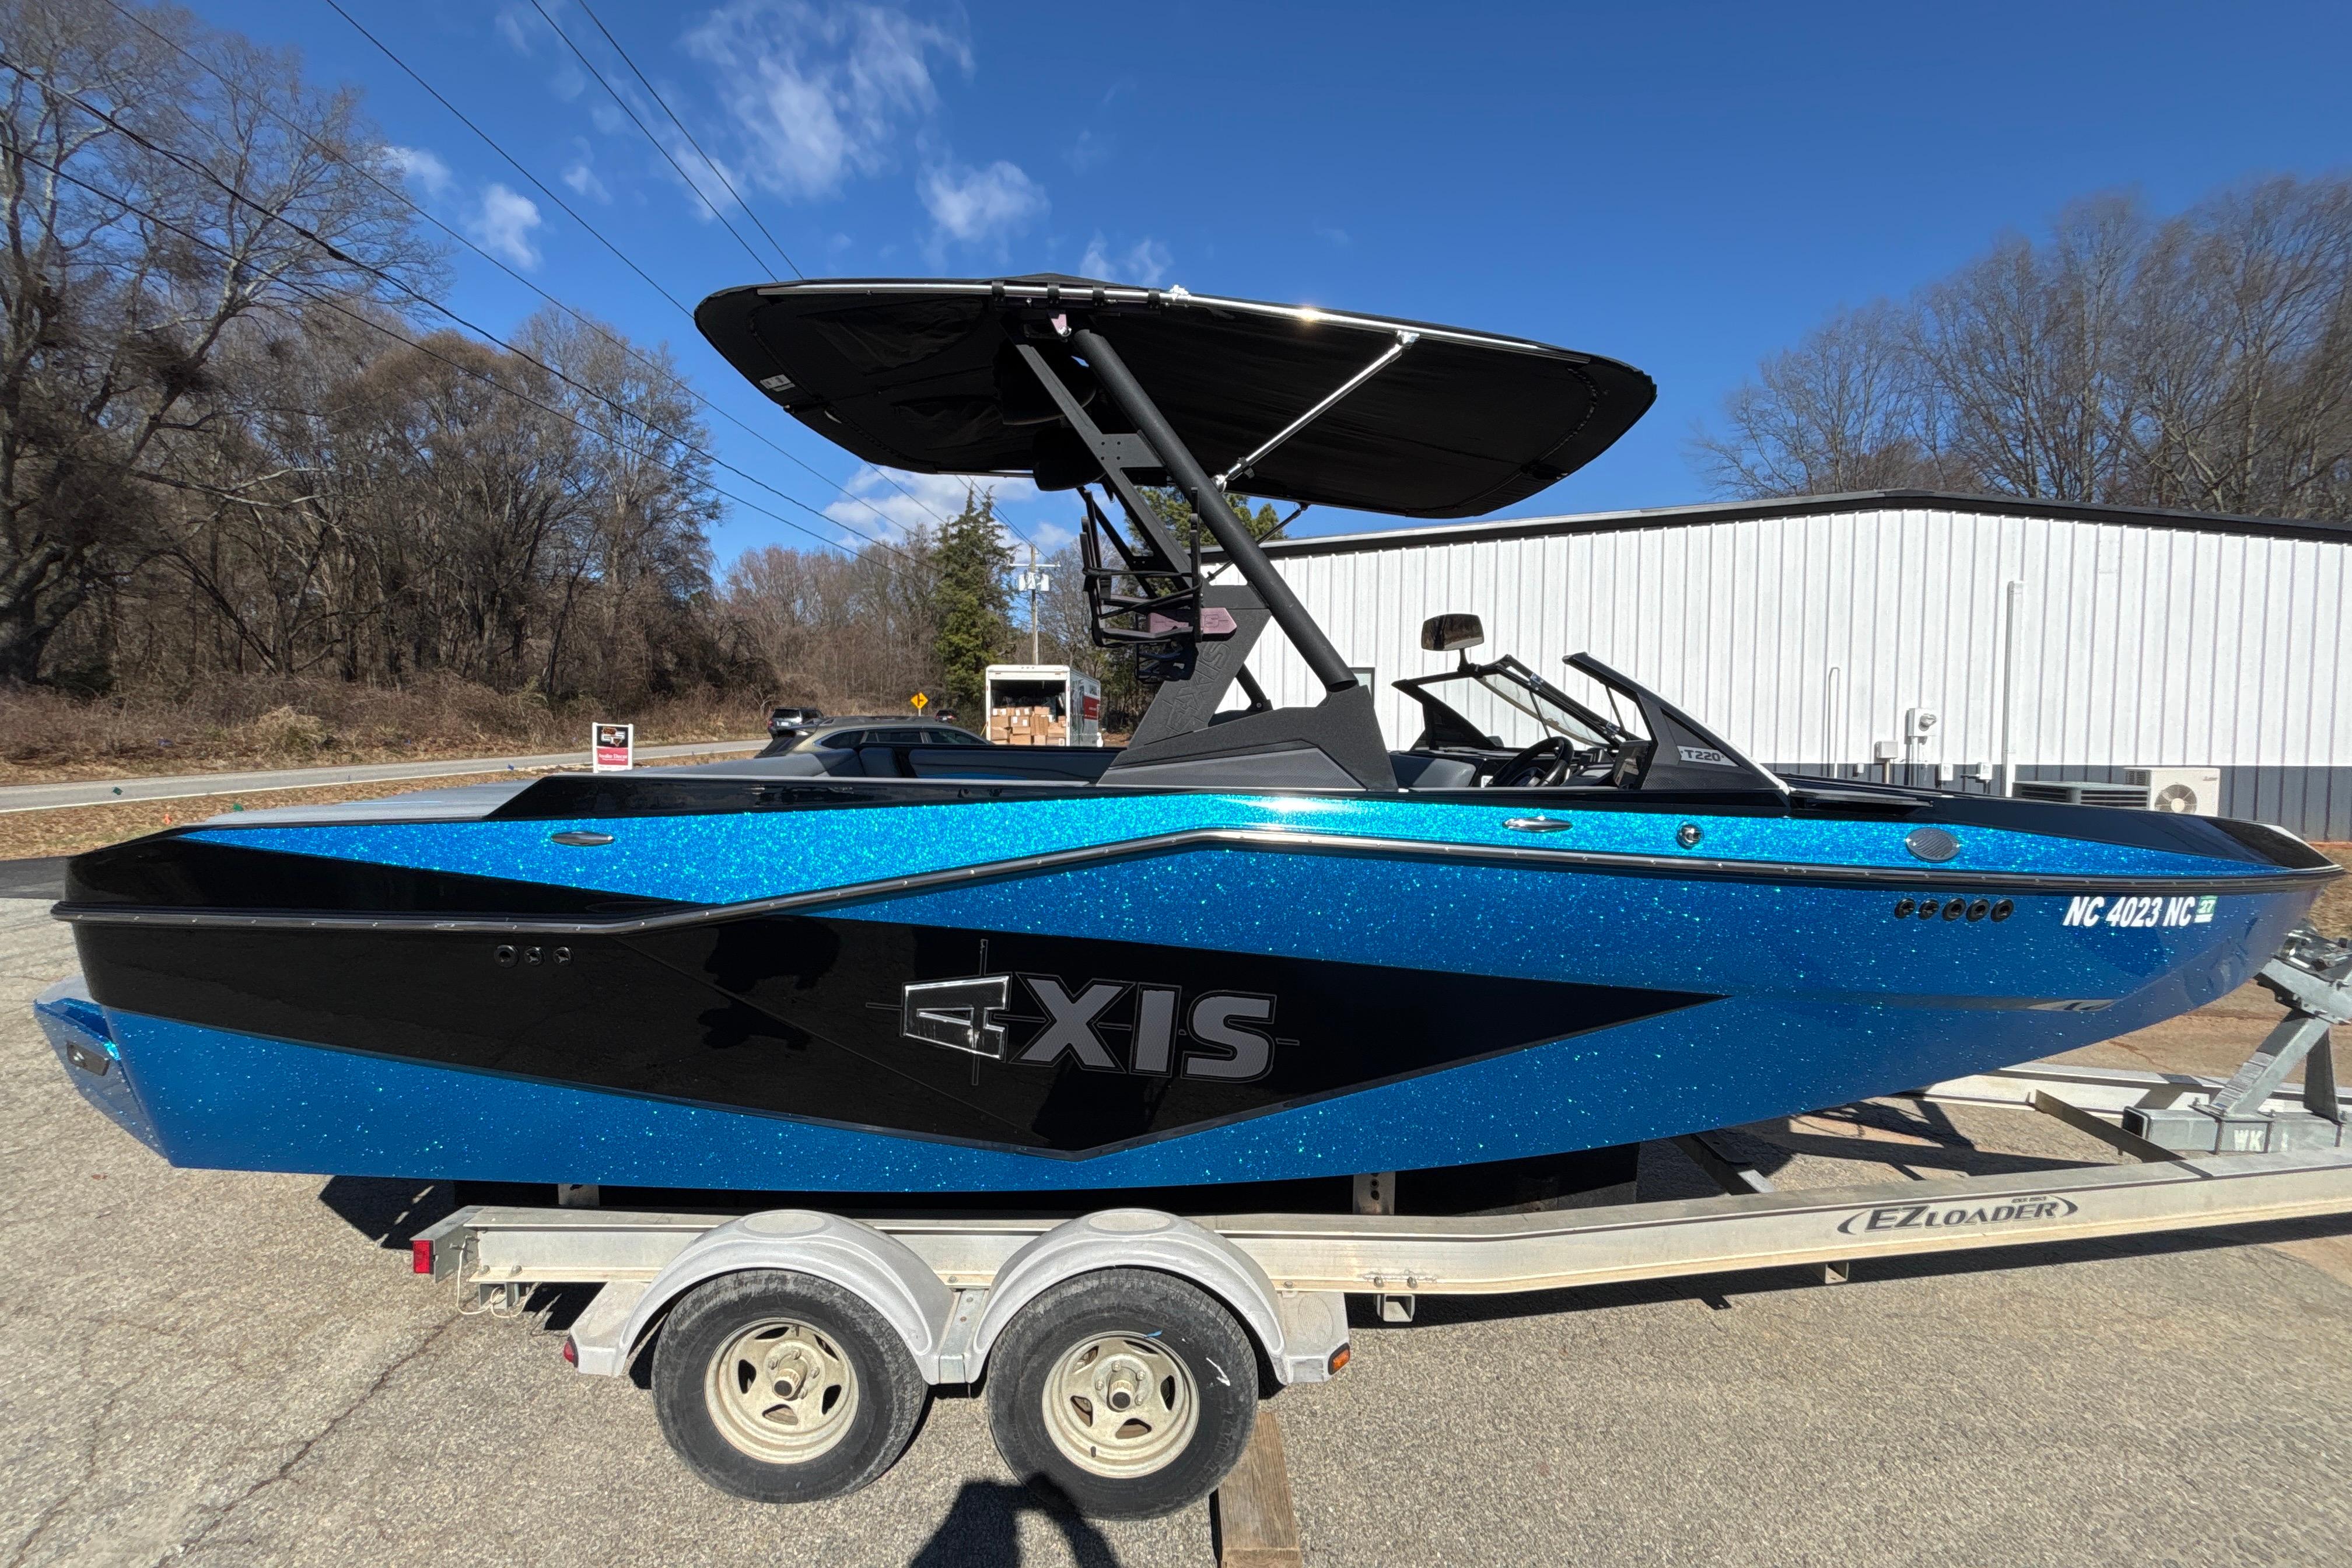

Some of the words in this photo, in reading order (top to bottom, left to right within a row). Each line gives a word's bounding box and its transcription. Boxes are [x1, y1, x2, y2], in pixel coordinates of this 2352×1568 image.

[1684, 749, 1721, 762] T220
[2062, 896, 2105, 927] NC
[2105, 896, 2162, 928] 4023
[2162, 896, 2196, 927] NC
[2197, 900, 2216, 914] 27
[900, 971, 1278, 1083] AXIS
